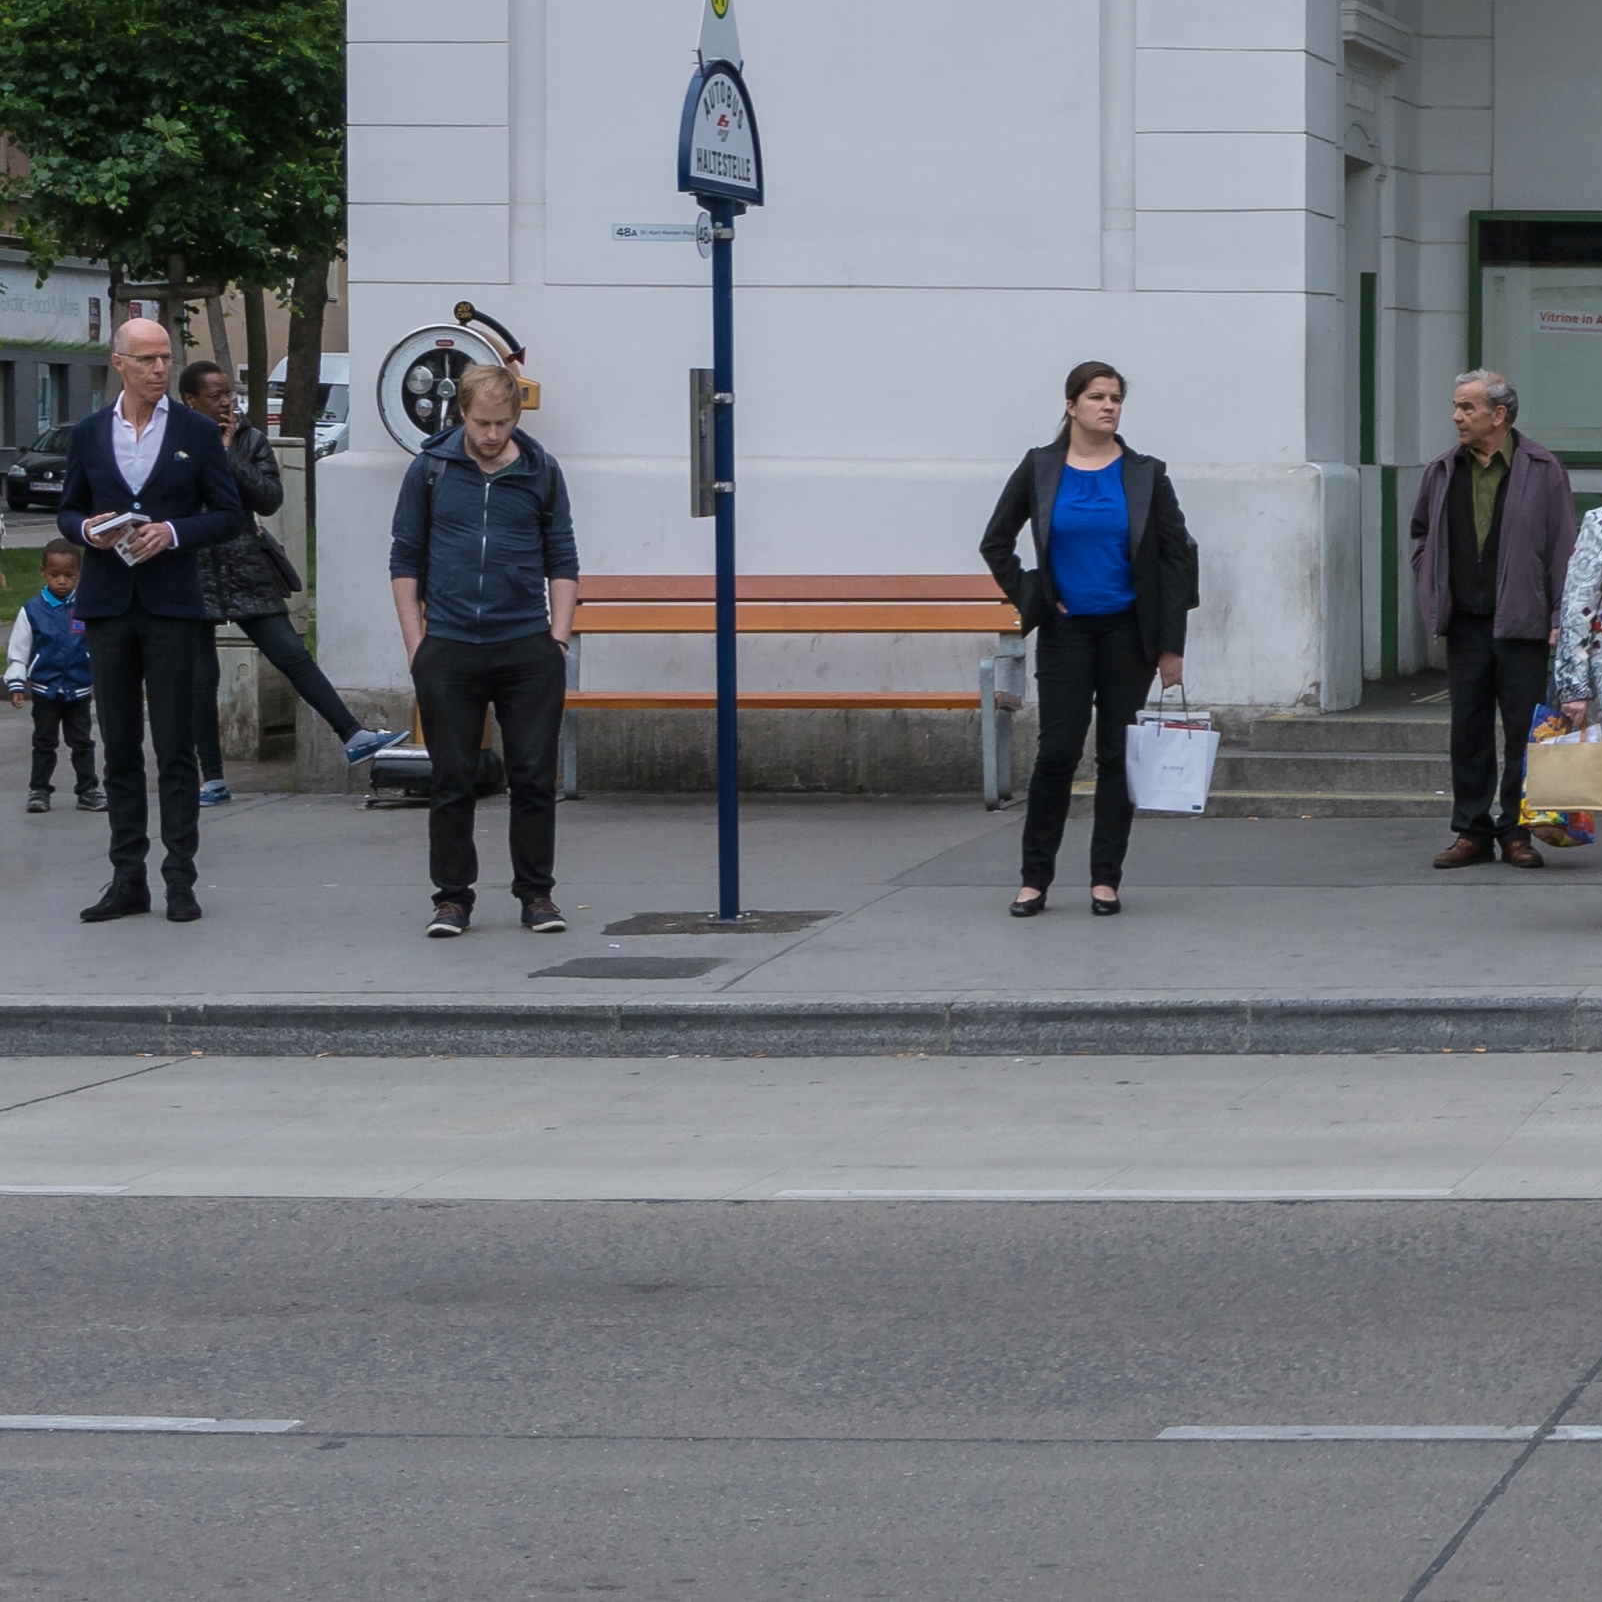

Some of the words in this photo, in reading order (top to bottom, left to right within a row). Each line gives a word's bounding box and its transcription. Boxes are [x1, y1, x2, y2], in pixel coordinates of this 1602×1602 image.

[703, 80, 744, 129] AUTOBUS
[696, 147, 751, 182] HALTESTELLE
[615, 227, 639, 237] 48A
[1539, 311, 1579, 324] Vitrine
[1582, 314, 1593, 324] in
